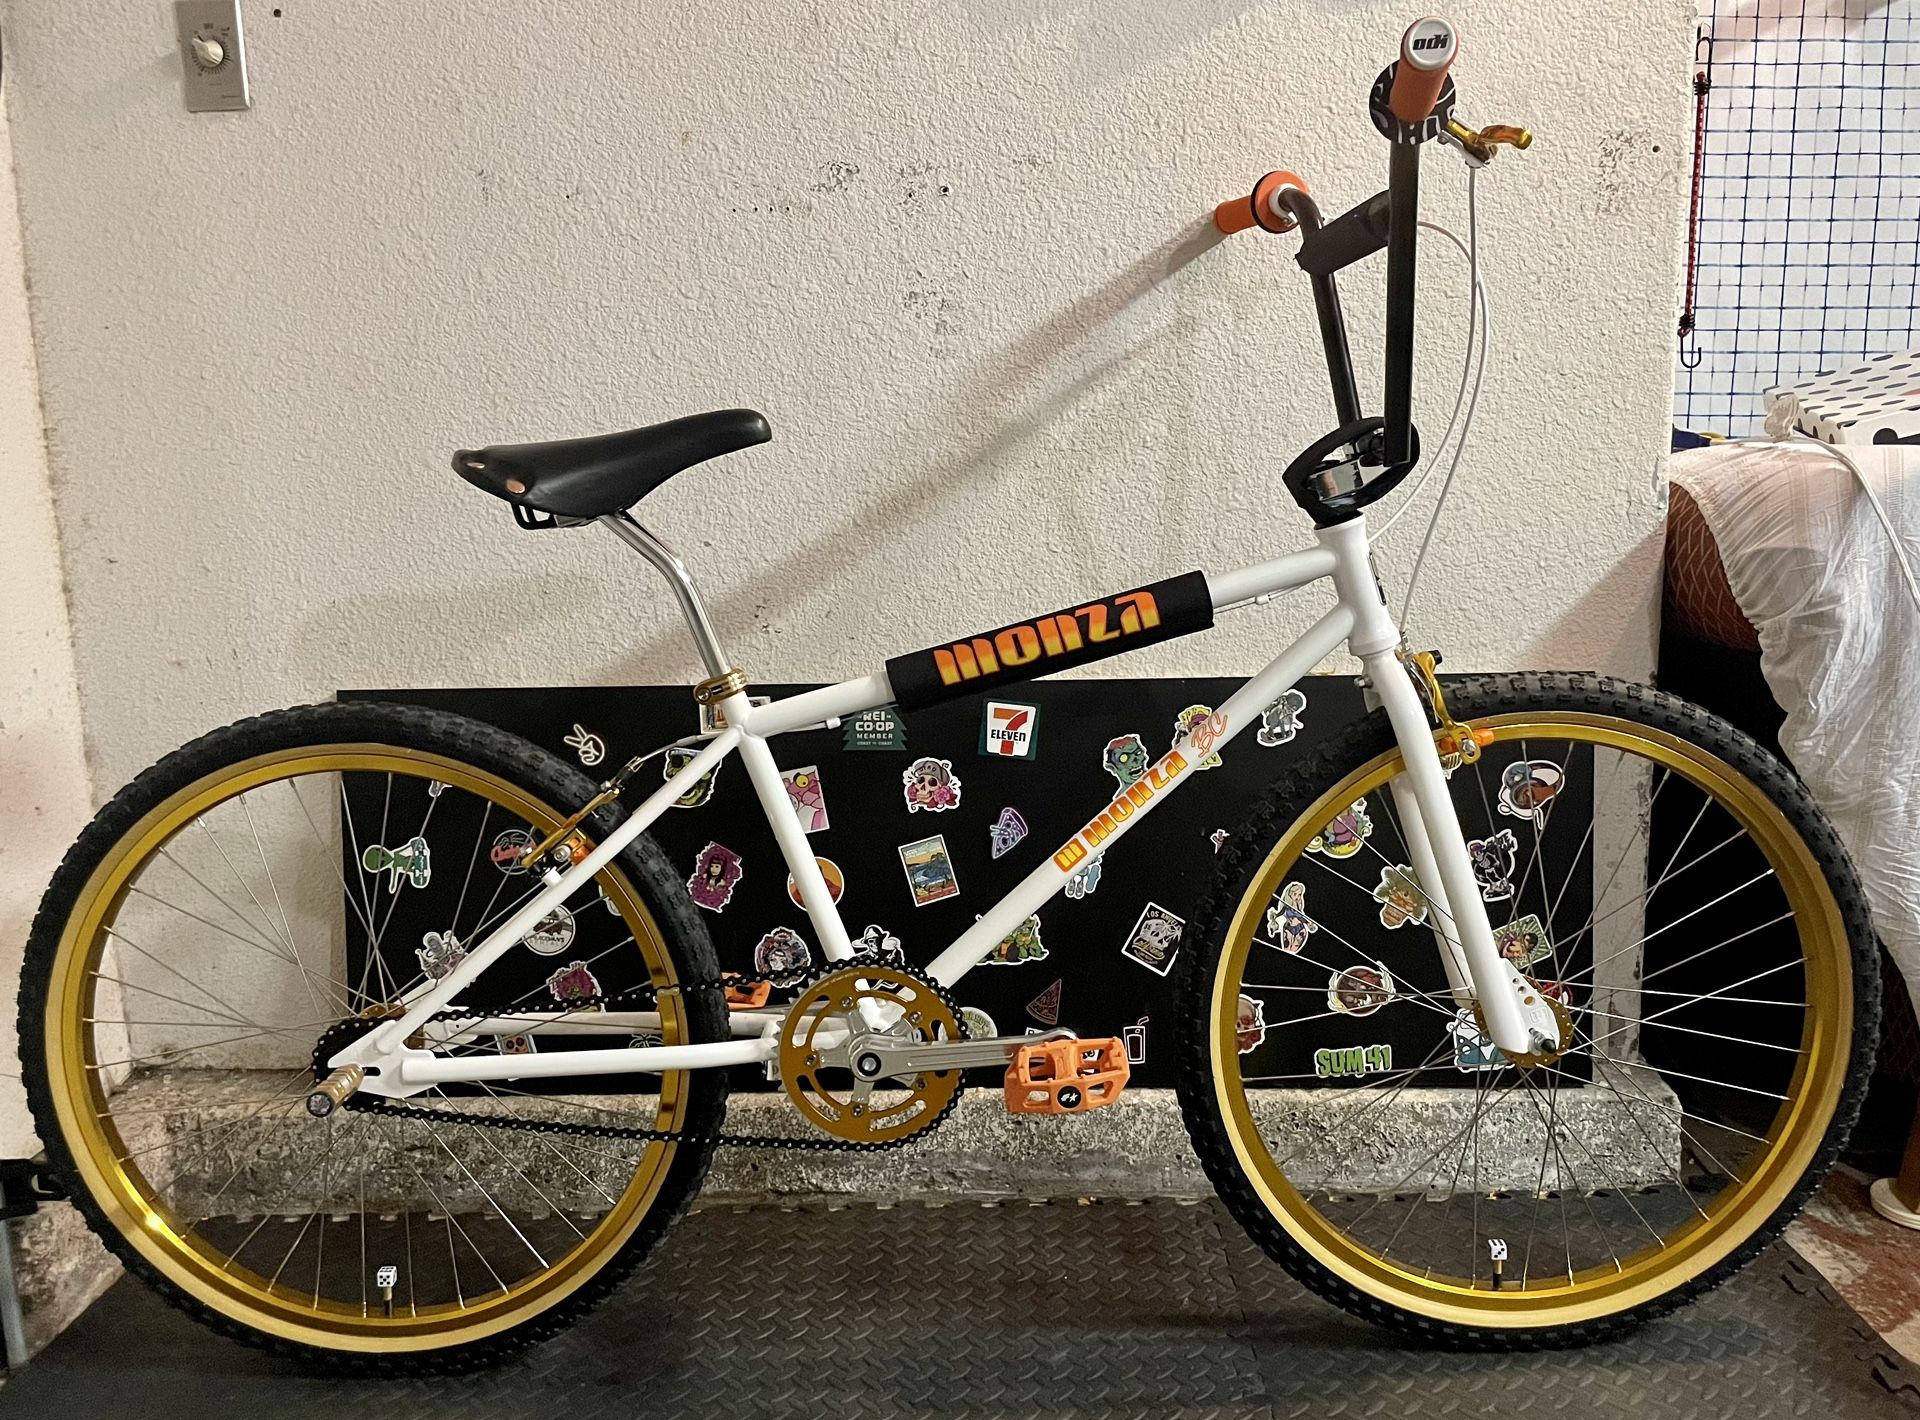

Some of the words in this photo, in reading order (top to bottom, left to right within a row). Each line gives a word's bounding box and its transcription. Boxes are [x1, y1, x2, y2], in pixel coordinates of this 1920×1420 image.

[1147, 910, 1160, 918] LOS
[1316, 1047, 1365, 1076] SUM
[1365, 1045, 1392, 1071] 41
